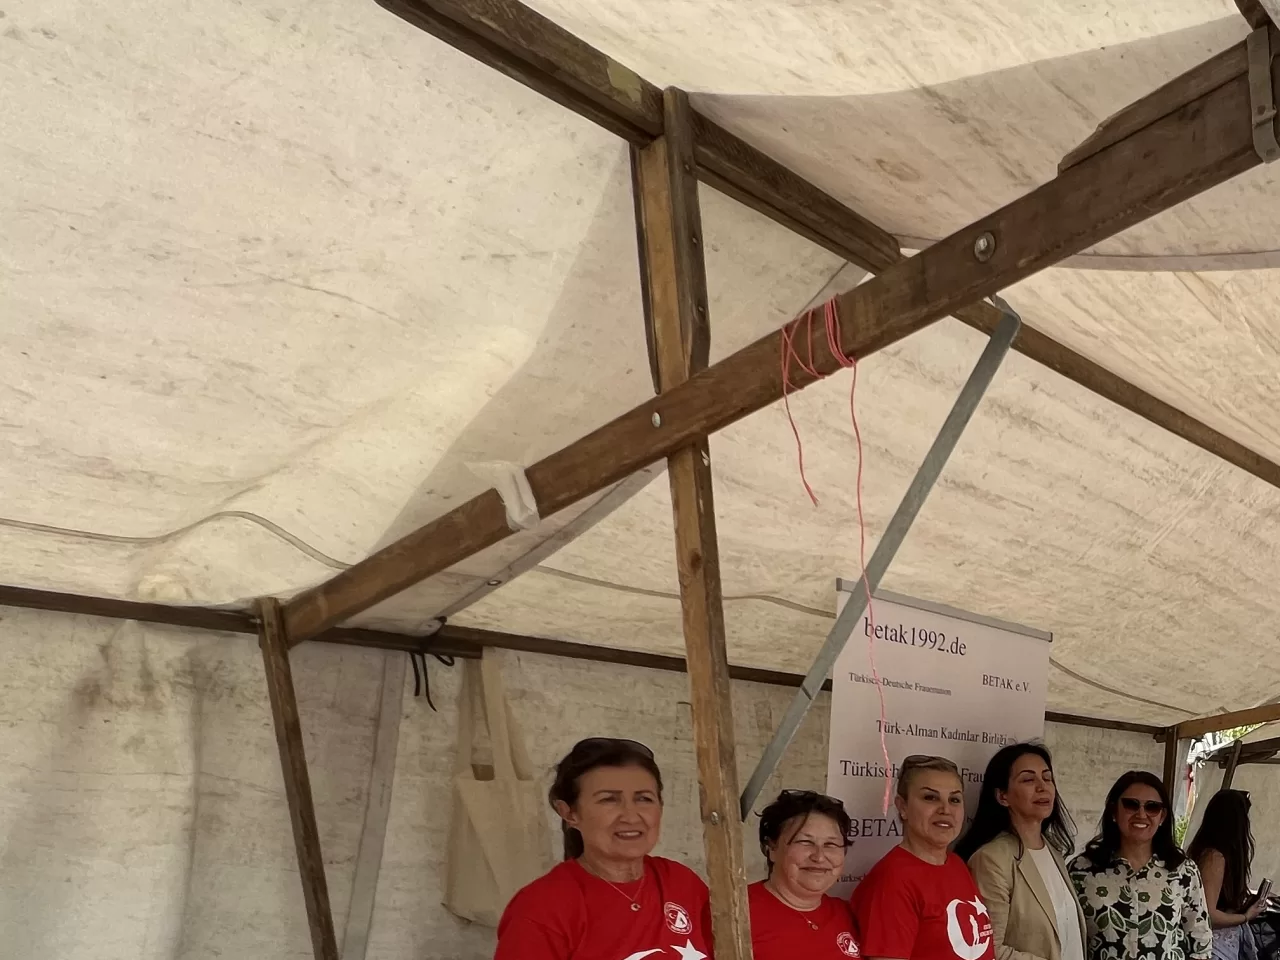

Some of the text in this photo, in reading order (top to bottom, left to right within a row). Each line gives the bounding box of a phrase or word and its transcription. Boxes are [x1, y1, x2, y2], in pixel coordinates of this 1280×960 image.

[864, 616, 967, 656] betak1992.de
[982, 674, 1013, 690] BETAK
[876, 719, 939, 739] Türk-Alman
[847, 818, 904, 837] BETA
